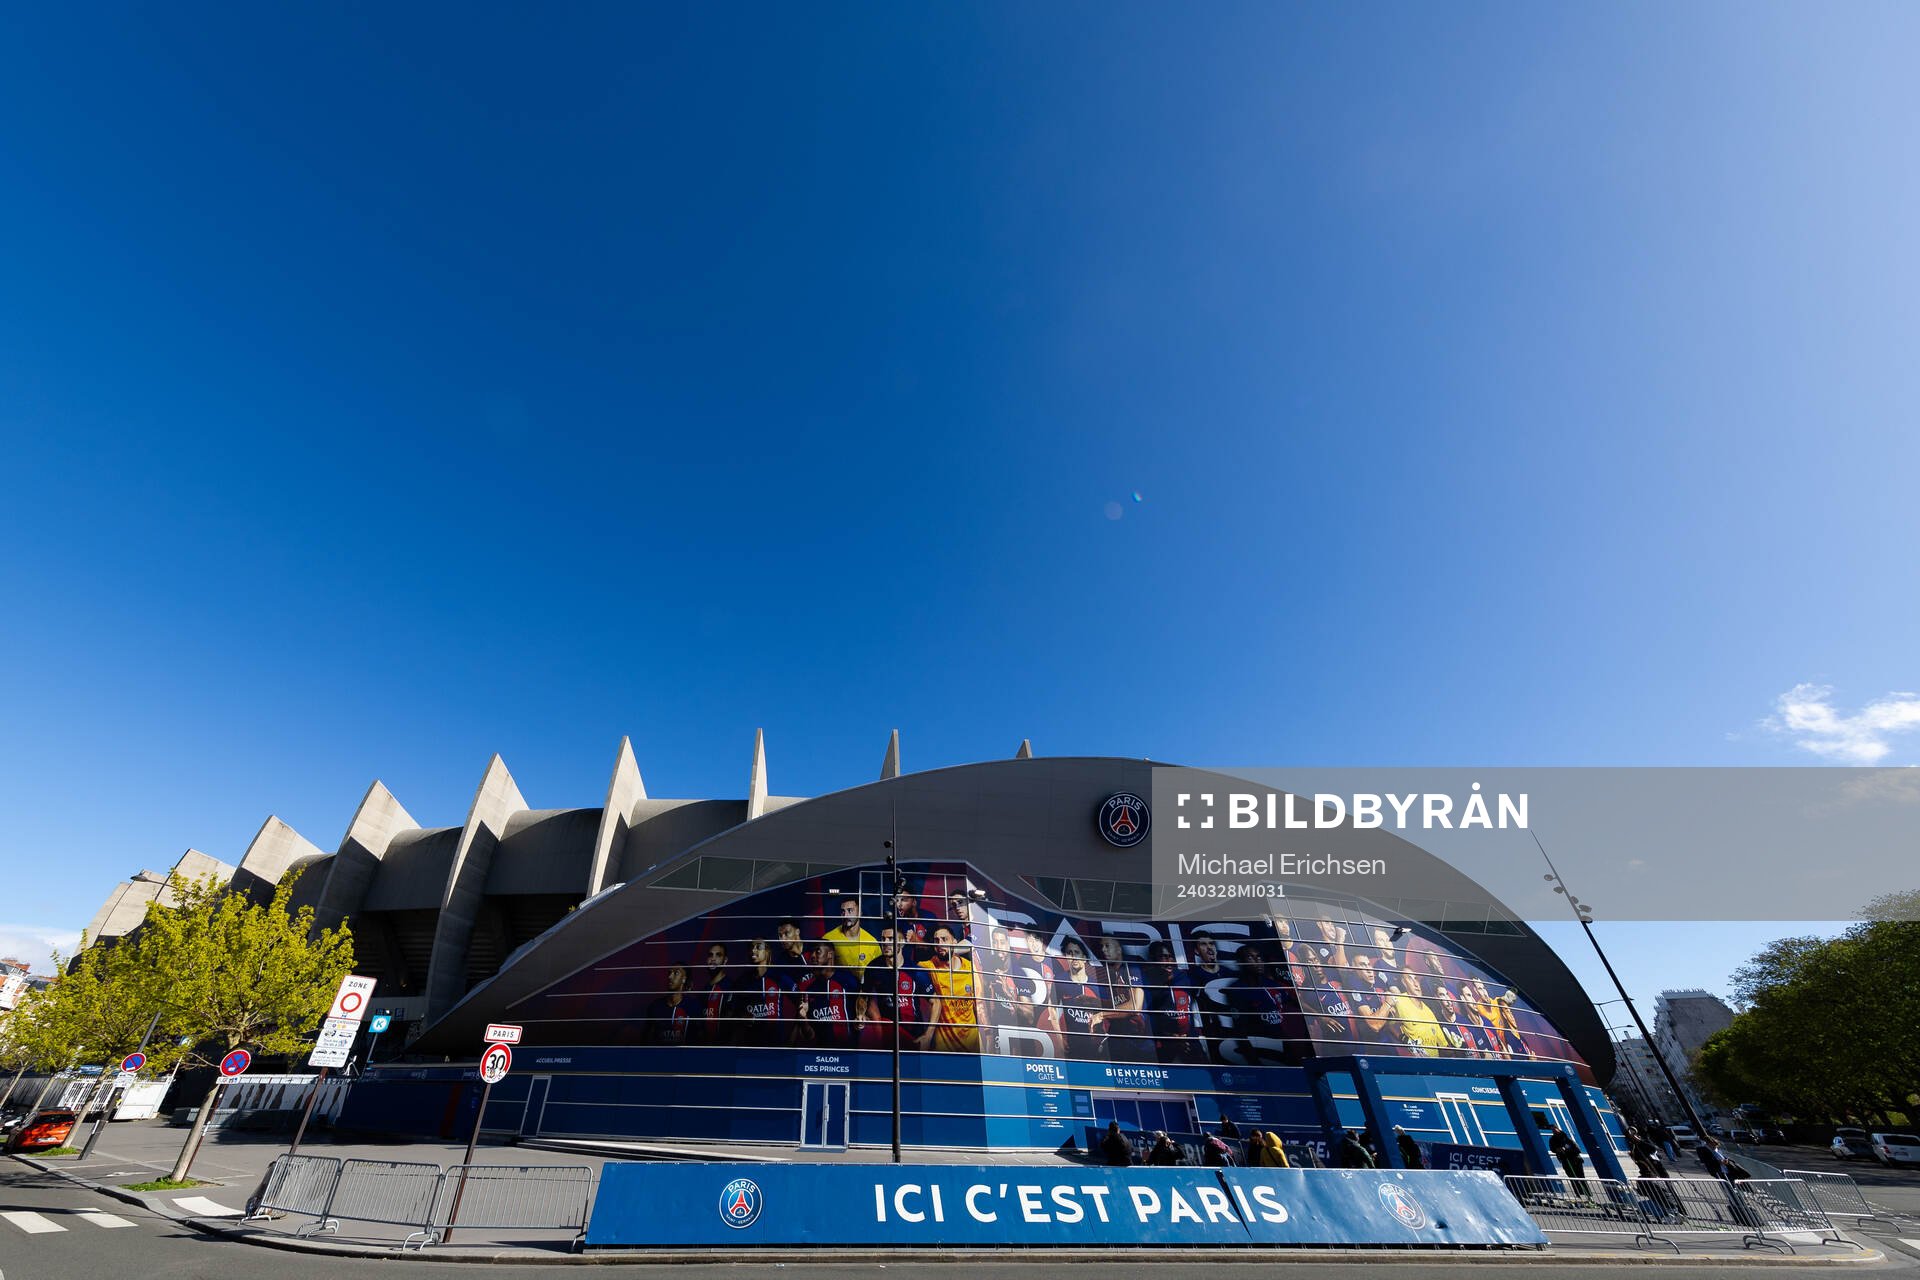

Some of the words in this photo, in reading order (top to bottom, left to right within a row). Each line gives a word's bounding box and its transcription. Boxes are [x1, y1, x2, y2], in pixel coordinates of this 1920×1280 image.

[1109, 796, 1143, 810] PARIS
[348, 981, 368, 989] ZONE
[812, 1005, 840, 1019] QATAR
[375, 1020, 384, 1029] K
[492, 1030, 515, 1038] PARIS
[489, 1053, 506, 1071] 30
[819, 1065, 850, 1073] PRINCES
[1026, 1063, 1054, 1073] PORTE
[1055, 1066, 1065, 1079] L
[1105, 1068, 1169, 1079] BIENVENUE
[1038, 1073, 1055, 1081] GATE
[1116, 1077, 1161, 1087] WELCOME
[1449, 1152, 1463, 1163] ICI
[1467, 1154, 1502, 1165] C'EST
[727, 1181, 756, 1193] PARIS
[874, 1183, 945, 1223] ICI
[964, 1183, 1110, 1223] C'EST
[1127, 1185, 1290, 1224] PARIS
